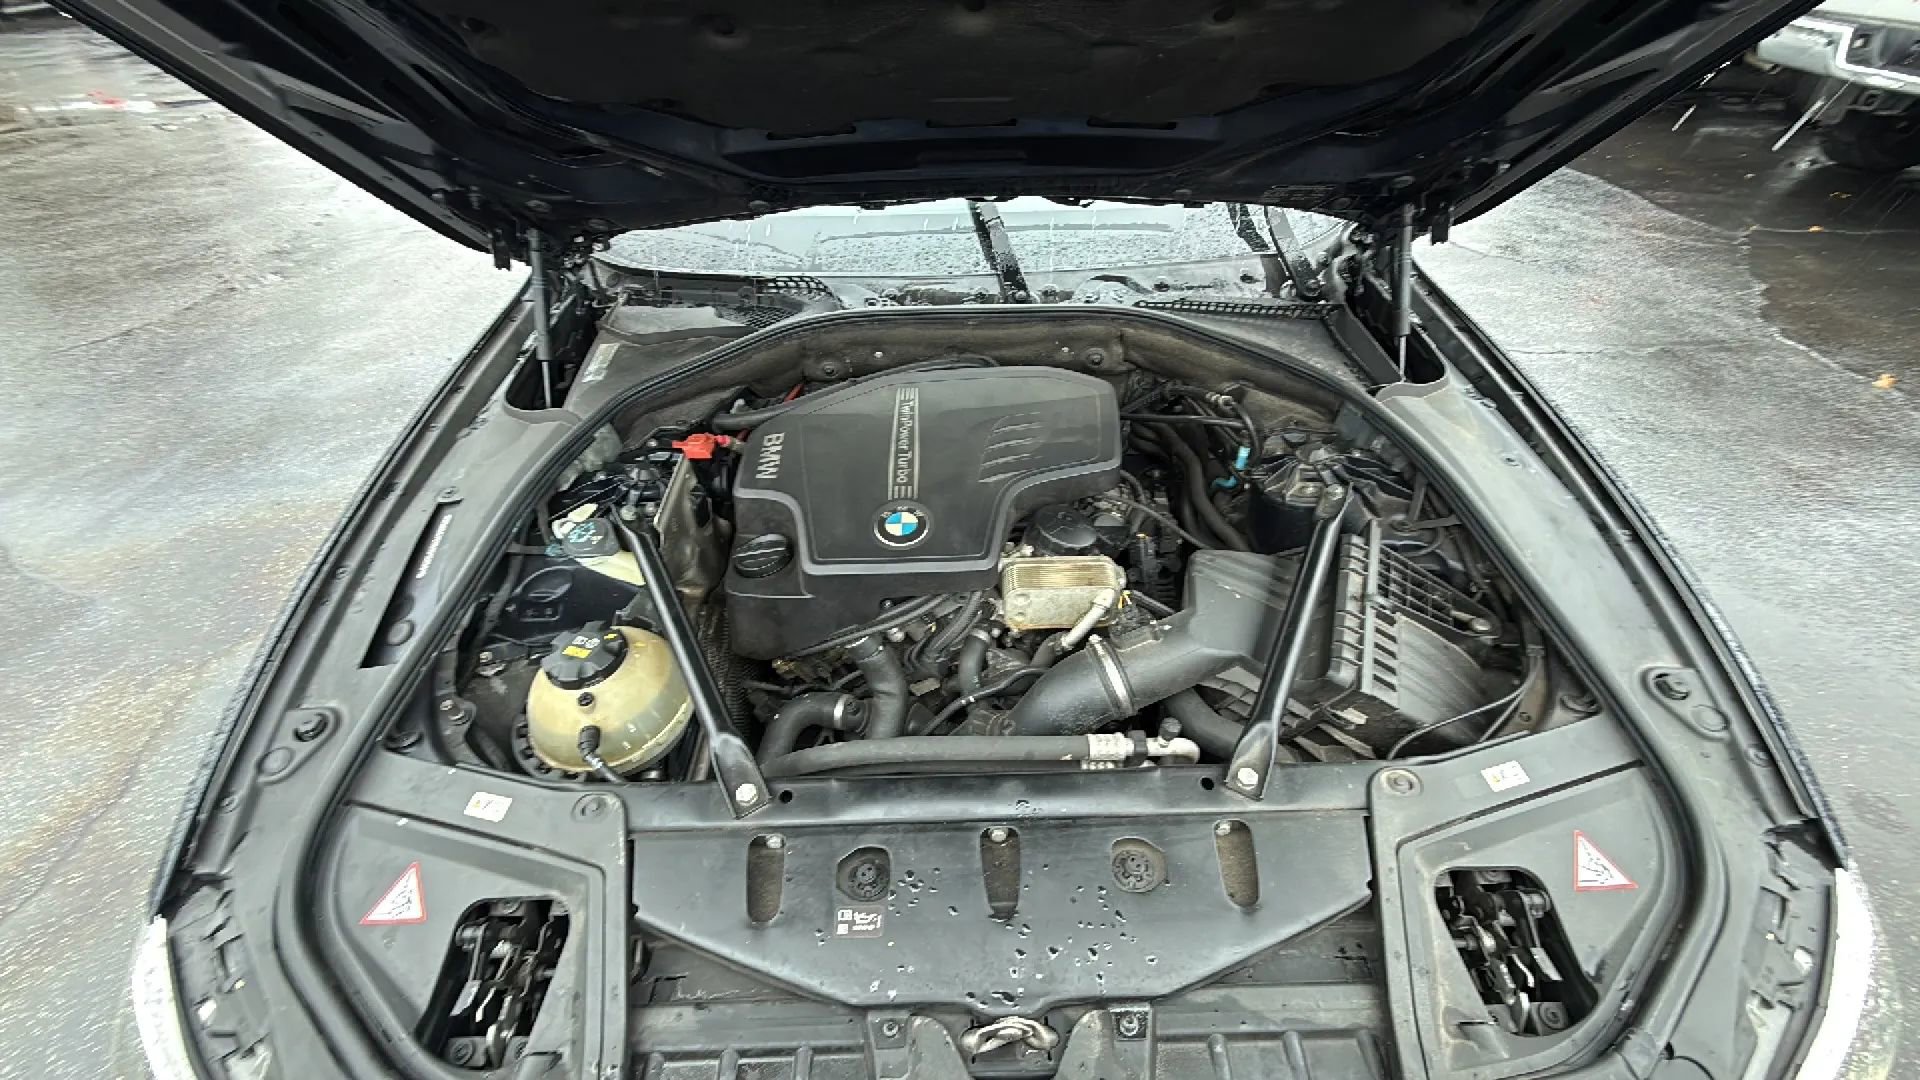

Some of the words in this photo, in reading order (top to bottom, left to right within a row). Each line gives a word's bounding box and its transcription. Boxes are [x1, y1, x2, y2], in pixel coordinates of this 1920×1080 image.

[898, 400, 914, 450] TwinPower
[755, 432, 785, 479] BMW
[896, 451, 912, 483] Turbo
